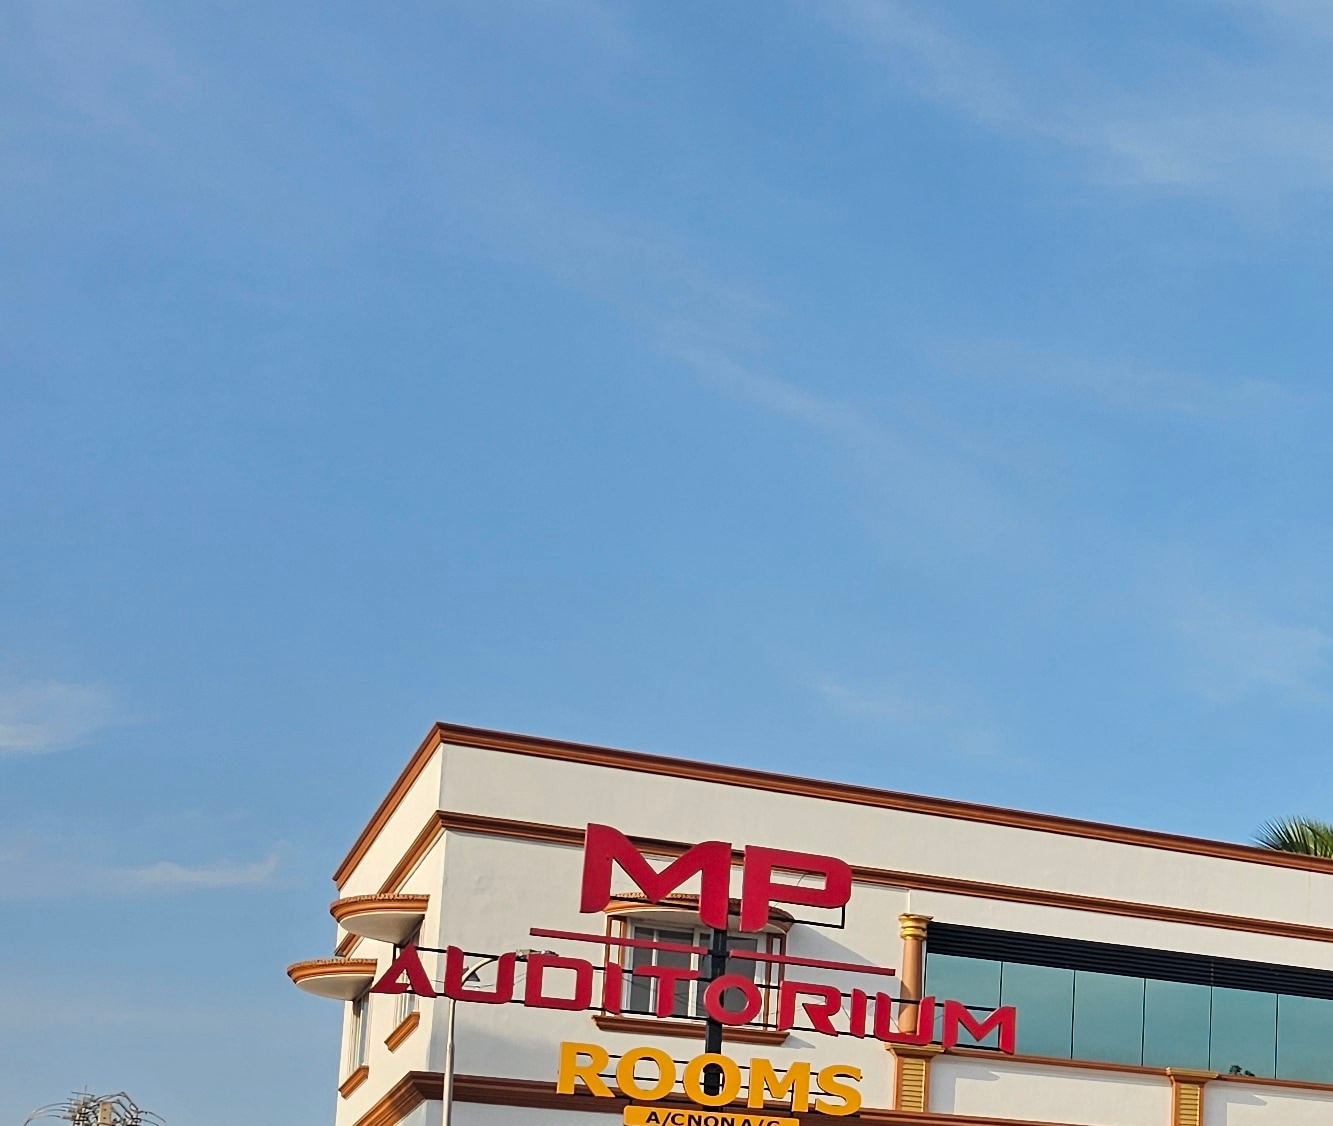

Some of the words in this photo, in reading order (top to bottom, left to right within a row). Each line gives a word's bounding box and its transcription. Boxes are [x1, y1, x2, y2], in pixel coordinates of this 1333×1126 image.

[579, 822, 853, 933] MP
[369, 940, 1017, 1056] AUDITORIUM
[556, 1041, 863, 1117] ROOMS
[645, 1111, 687, 1126] A/C
